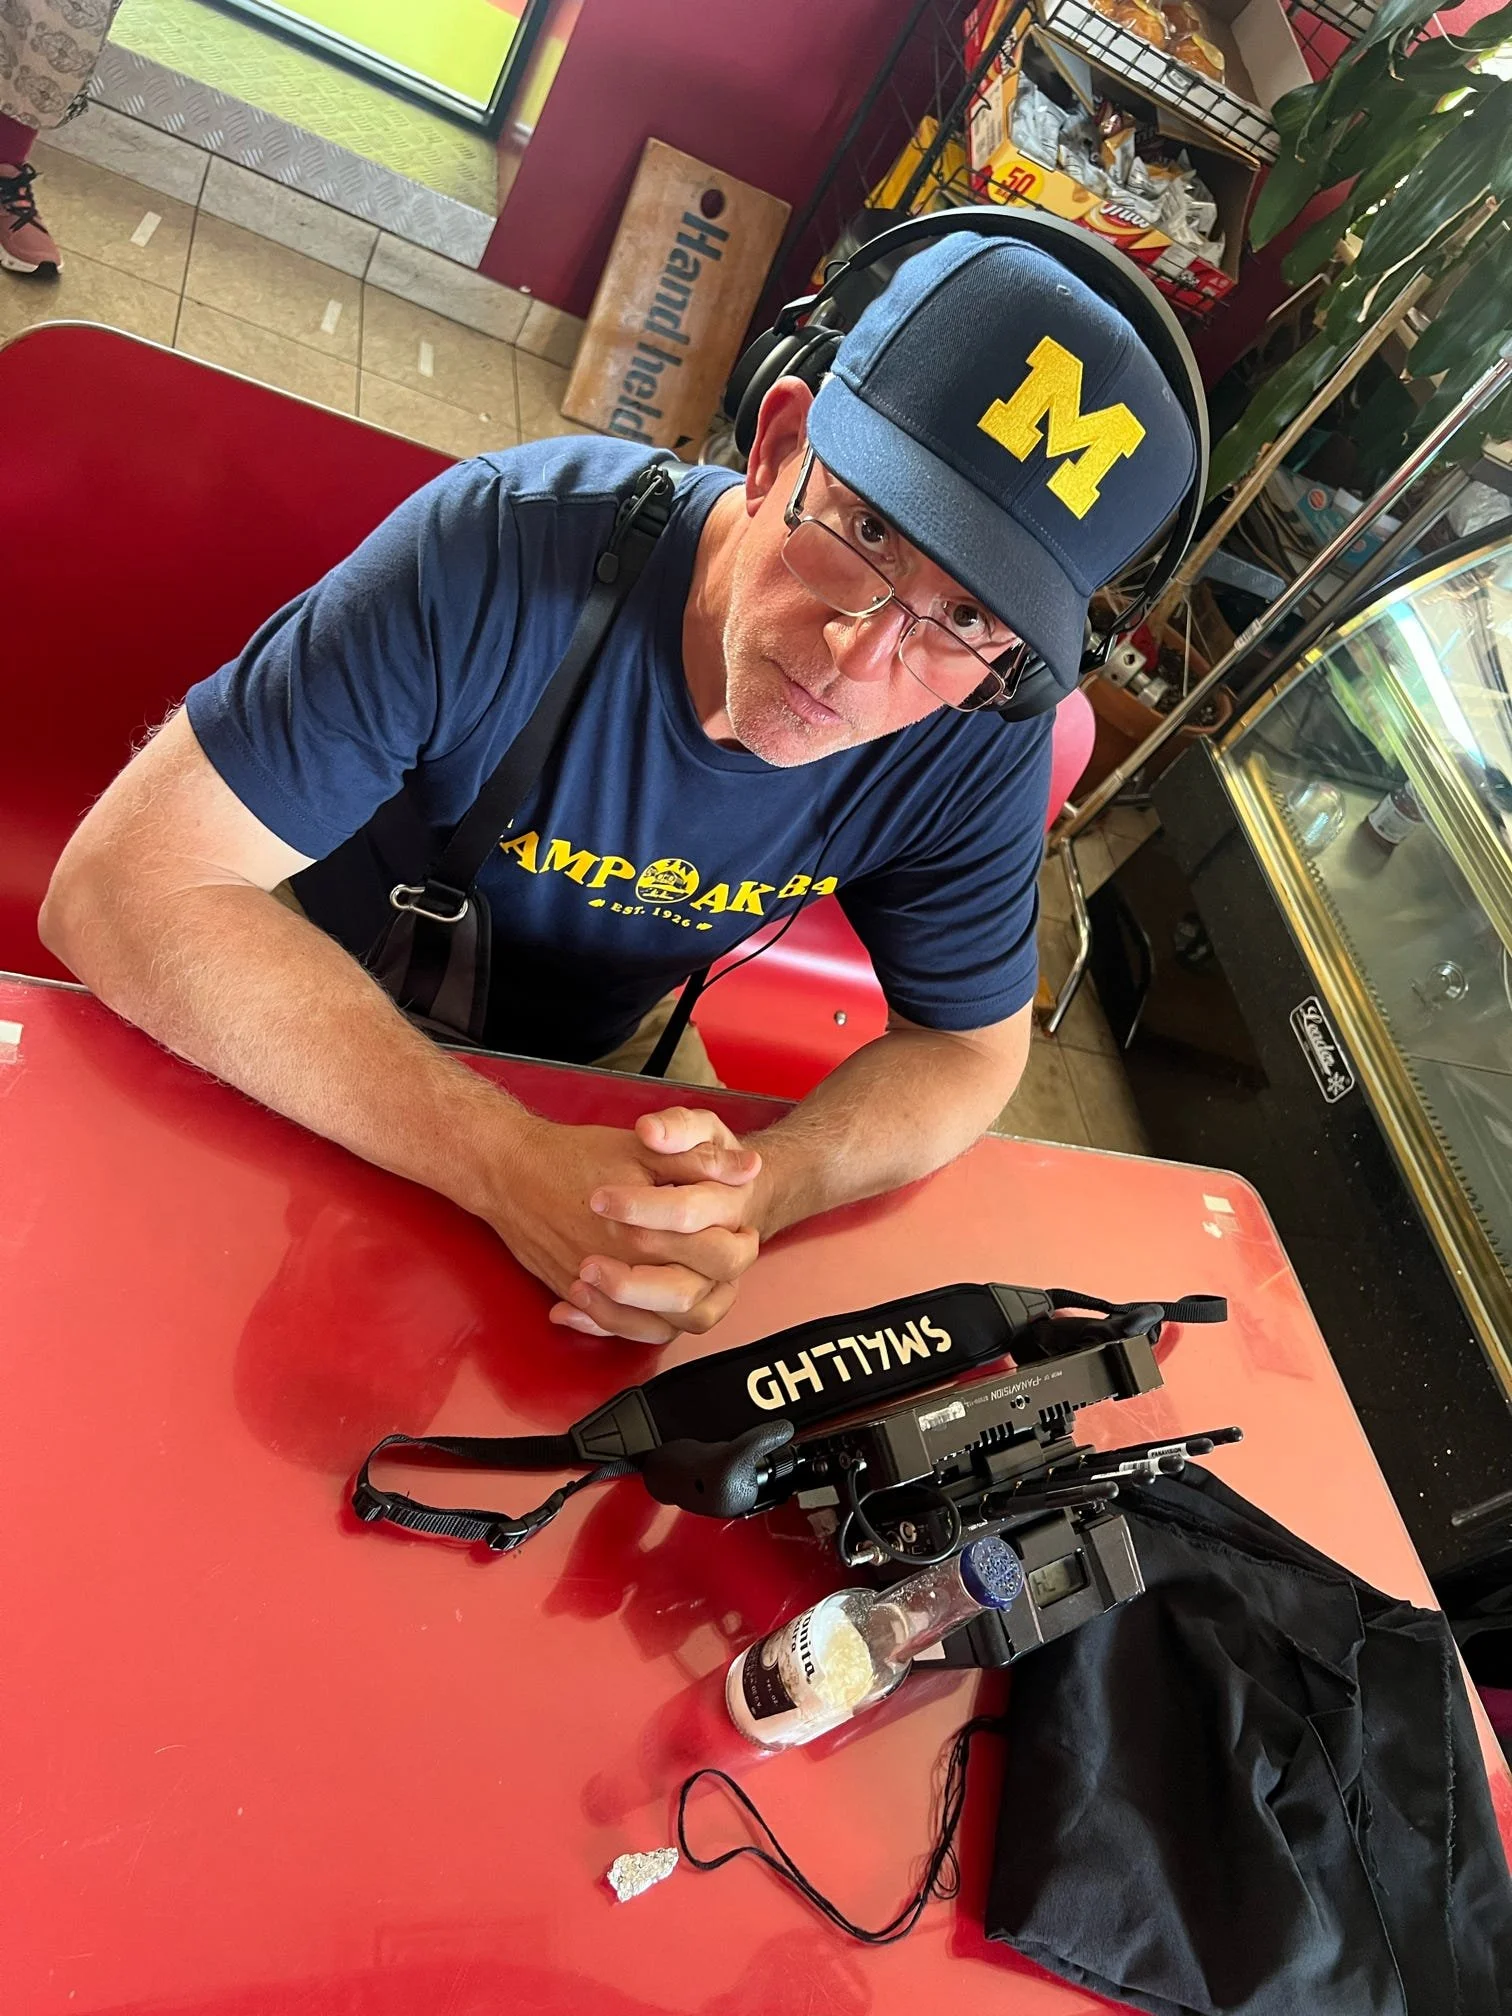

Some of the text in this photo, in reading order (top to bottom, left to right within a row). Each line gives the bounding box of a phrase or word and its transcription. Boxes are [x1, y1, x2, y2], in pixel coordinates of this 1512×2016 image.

[608, 211, 730, 444] Hand held
[977, 335, 1146, 520] M
[500, 819, 636, 888] AMP
[610, 902, 691, 928] EST. 1926
[746, 1315, 952, 1410] SMALLHD
[990, 1375, 1041, 1401] PANAVISION
